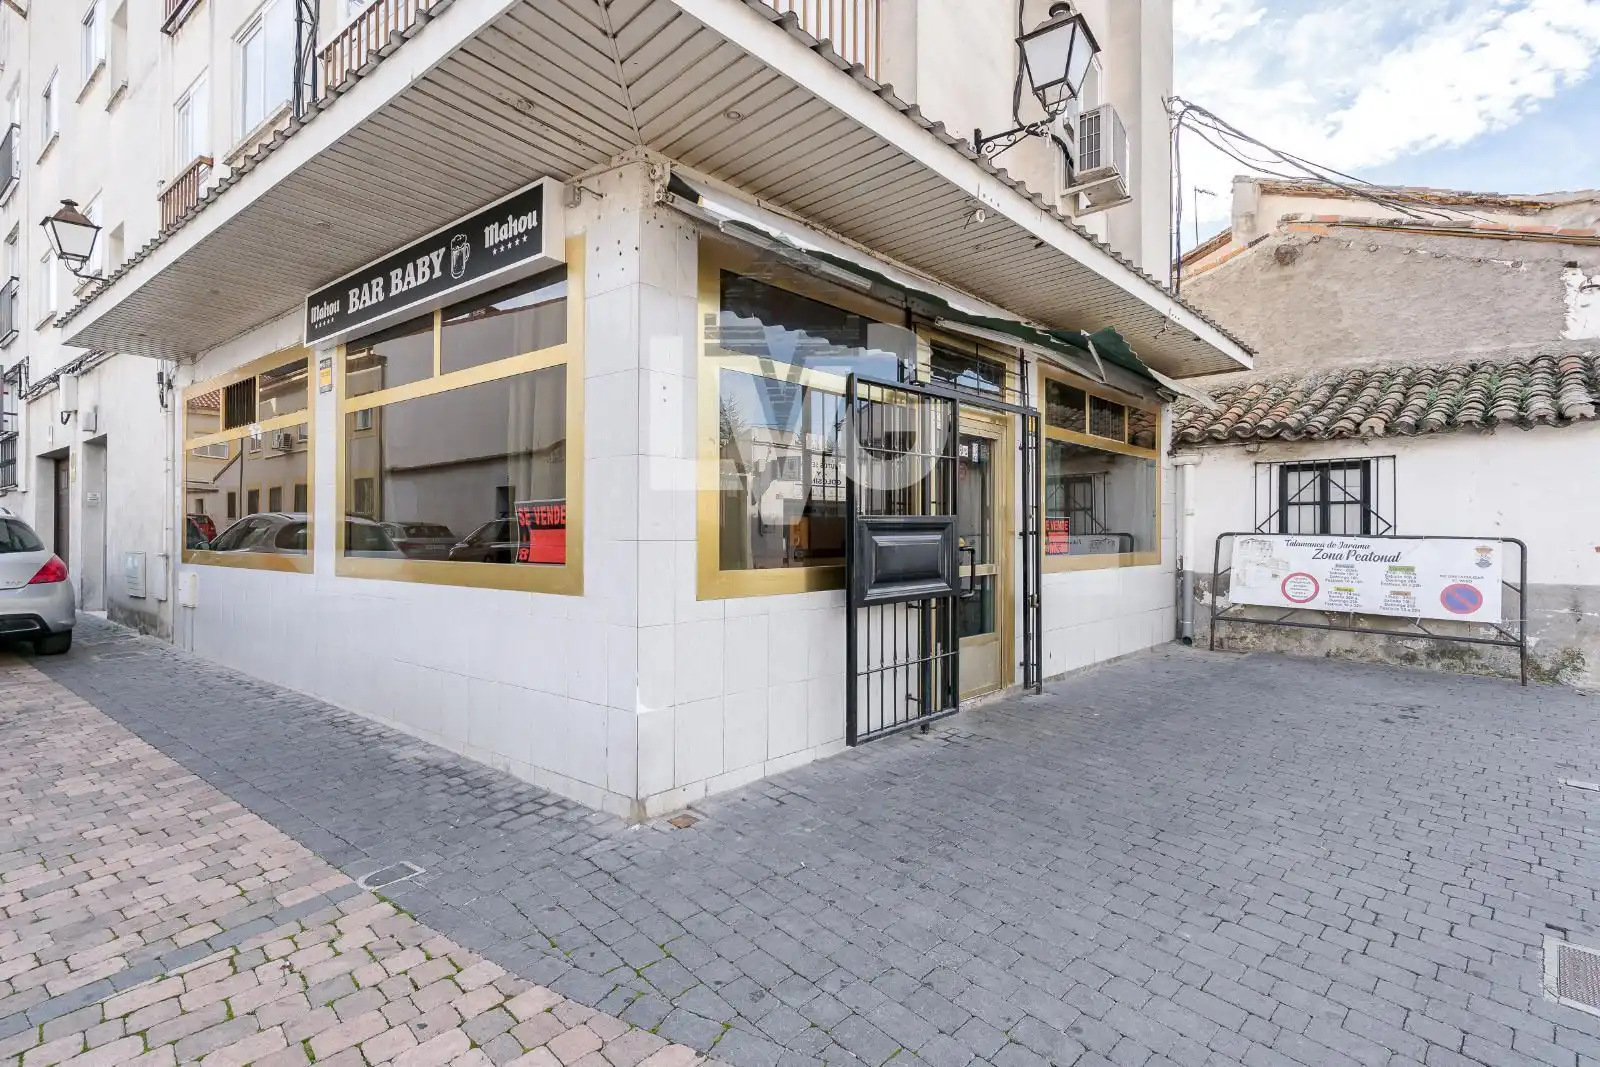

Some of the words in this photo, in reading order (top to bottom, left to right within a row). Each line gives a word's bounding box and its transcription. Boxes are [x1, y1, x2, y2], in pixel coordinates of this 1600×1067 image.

[484, 209, 538, 249] Mahou
[347, 275, 385, 314] BAR
[389, 247, 446, 297] BABY
[310, 298, 340, 324] Mahou
[518, 507, 531, 526] SE
[533, 505, 566, 525] VENDE
[1284, 539, 1325, 548] Talamanca
[1326, 541, 1337, 549] de
[1339, 541, 1371, 550] Jarama
[1312, 548, 1344, 561] Zona
[1345, 549, 1402, 563] Peatonal
